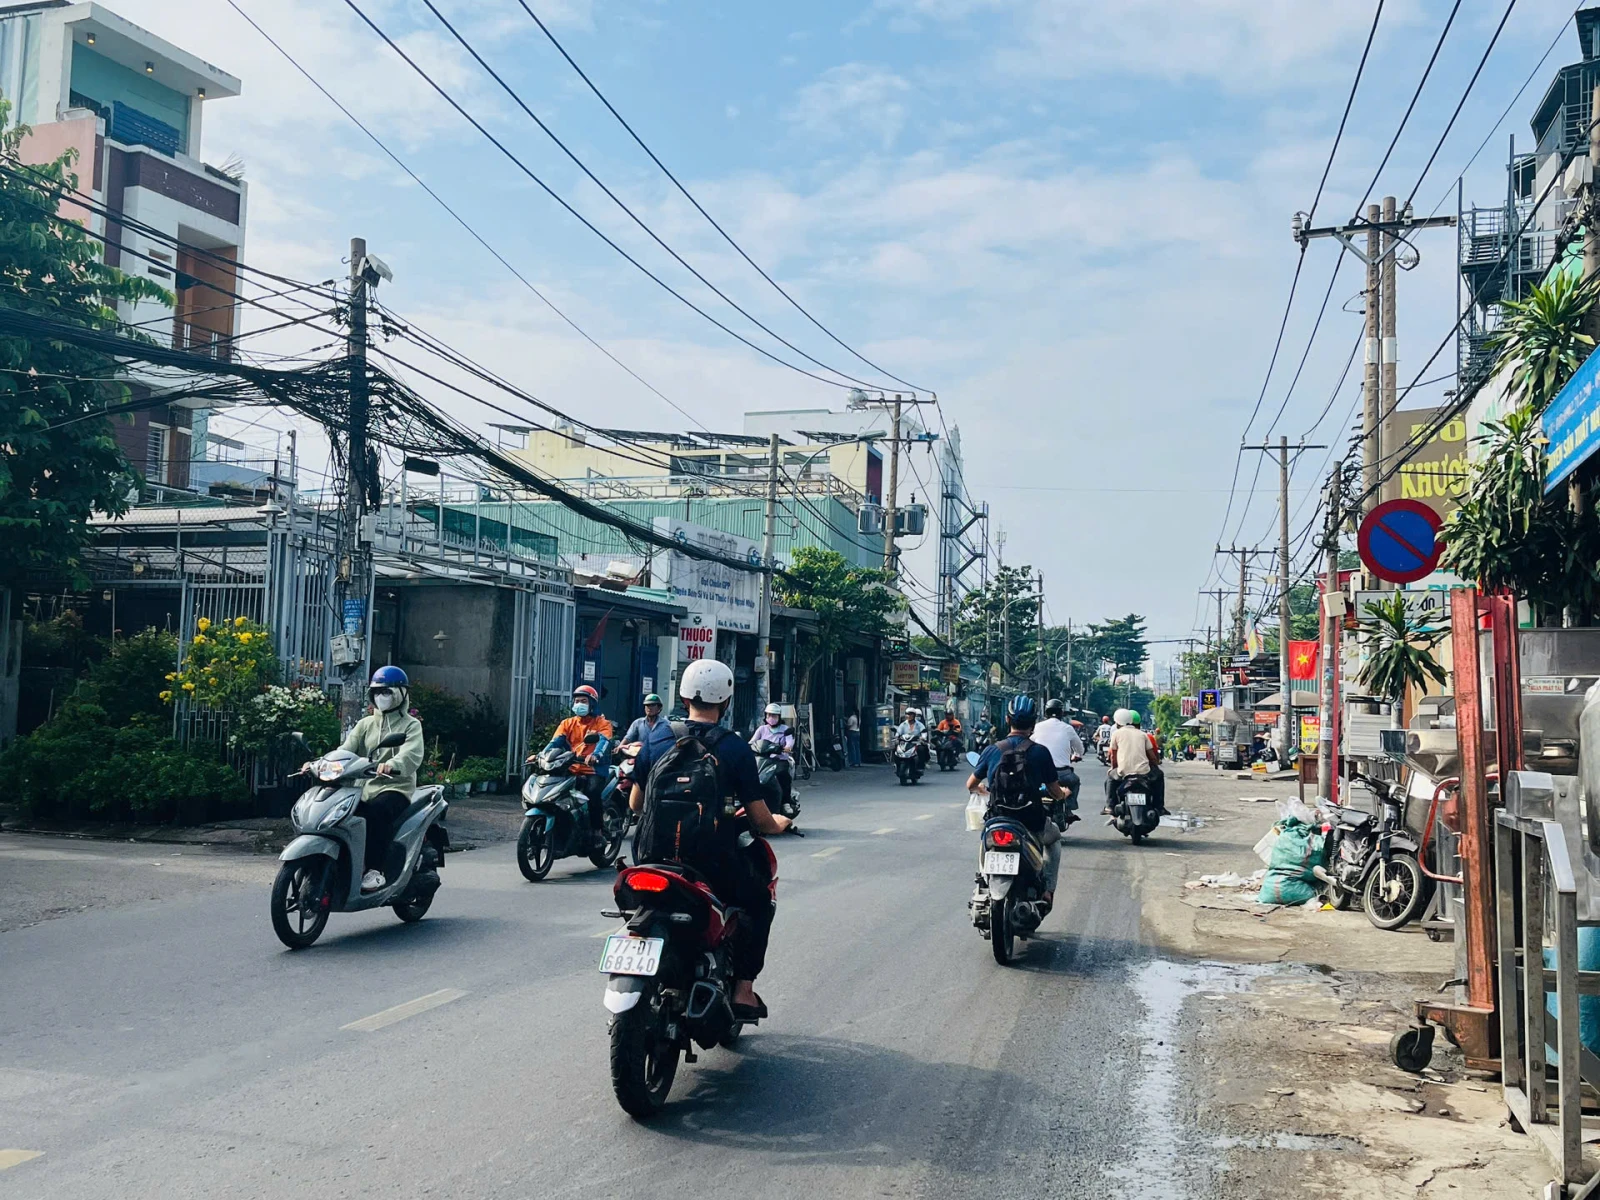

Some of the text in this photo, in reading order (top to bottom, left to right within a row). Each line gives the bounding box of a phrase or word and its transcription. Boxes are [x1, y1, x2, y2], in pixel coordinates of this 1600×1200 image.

[680, 626, 713, 643] THUỐC
[687, 643, 705, 660] TÂY
[604, 955, 656, 973] 683.40
